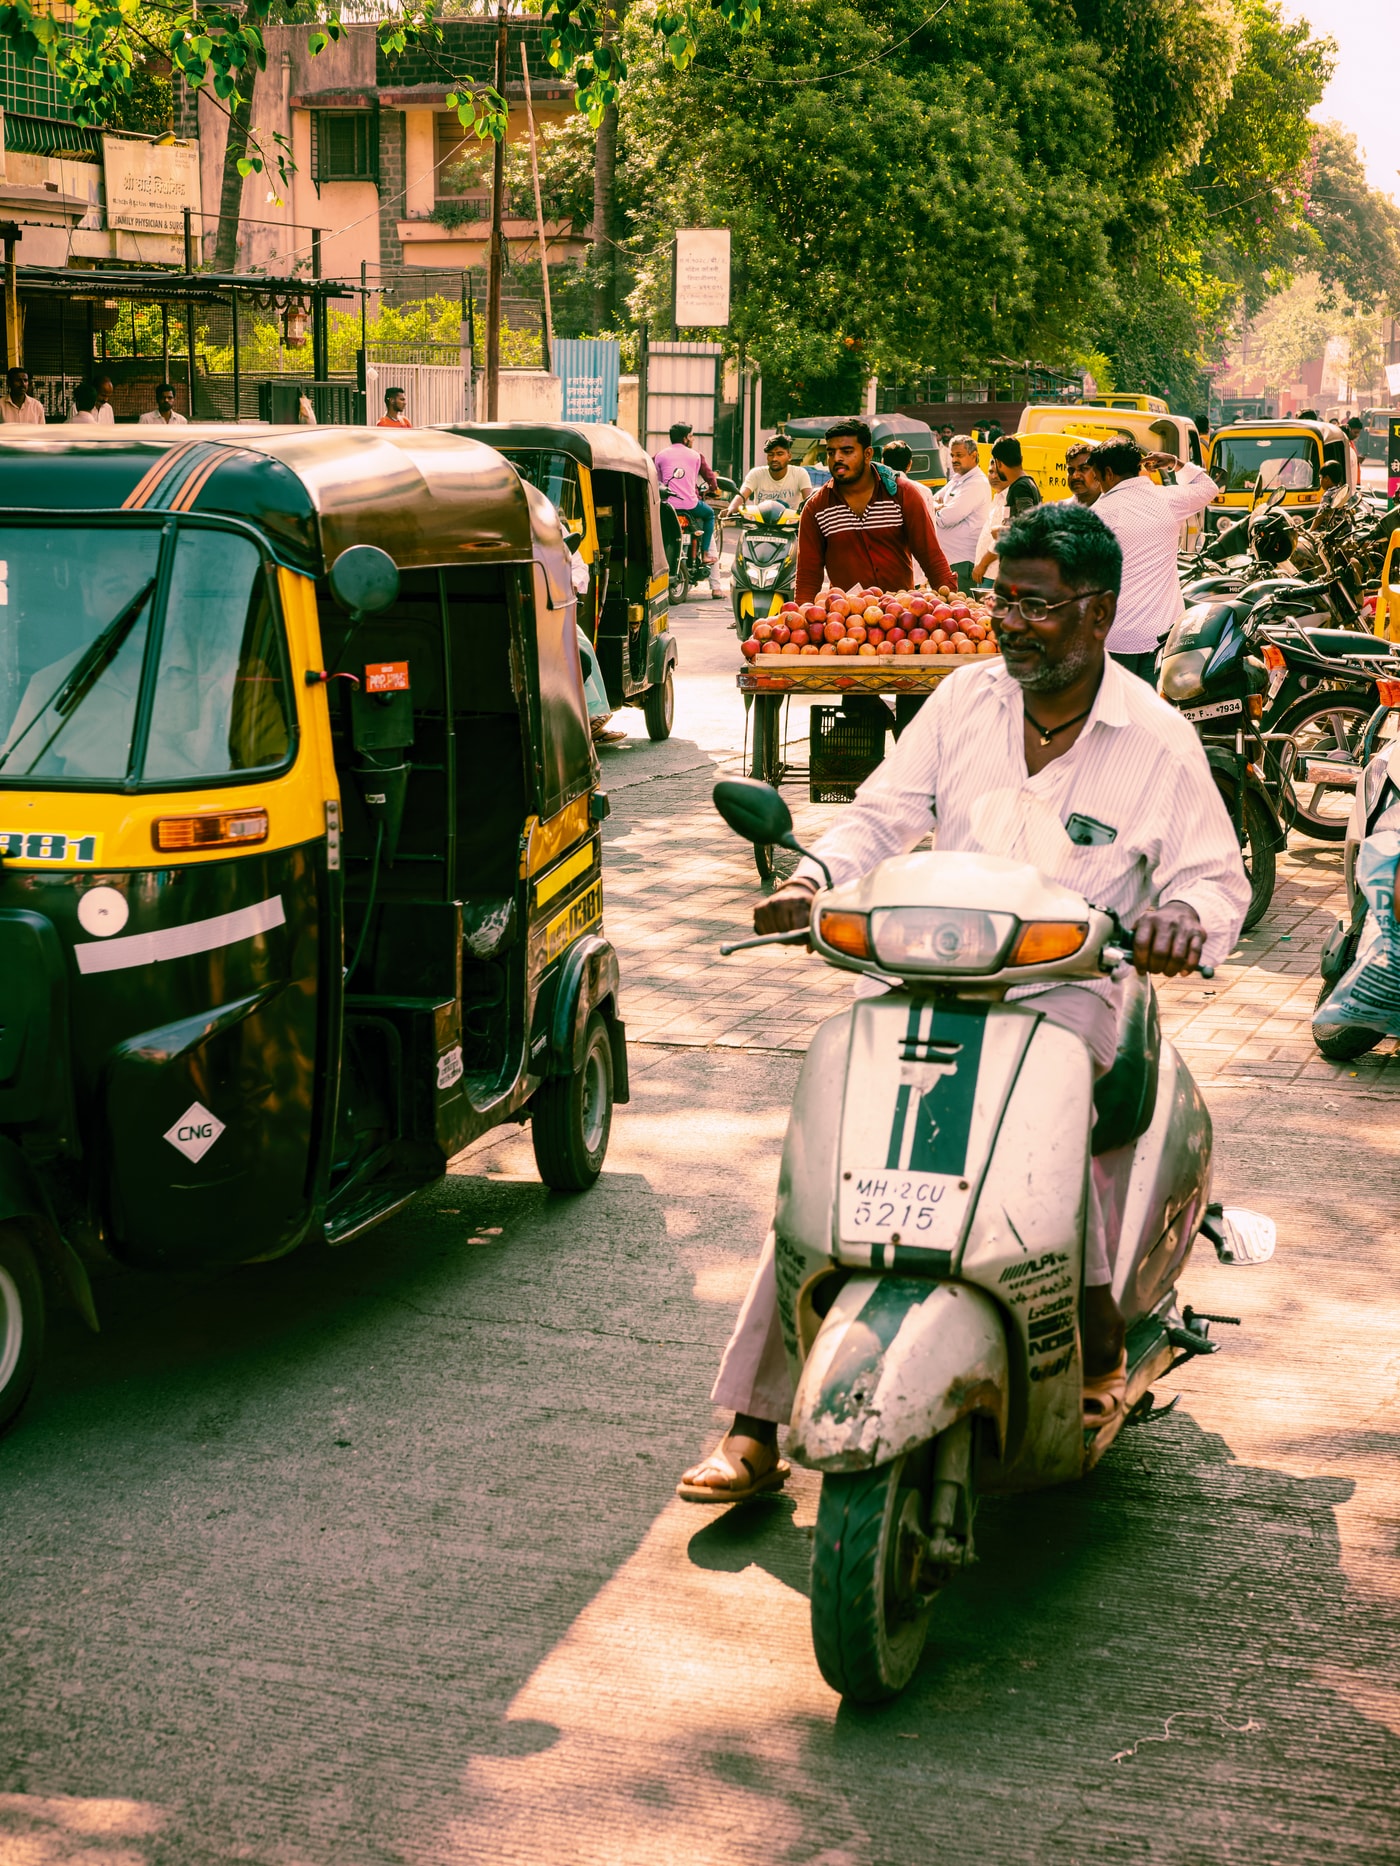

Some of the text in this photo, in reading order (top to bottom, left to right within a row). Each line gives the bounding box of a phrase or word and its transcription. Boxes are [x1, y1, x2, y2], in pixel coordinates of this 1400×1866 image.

[135, 218, 163, 229] PHYSICIAN
[164, 221, 168, 229] &
[169, 221, 195, 232] SURGN
[568, 882, 600, 939] 0381
[178, 1123, 213, 1141] CNG
[856, 1179, 888, 1197] MH
[916, 1183, 945, 1203] CU
[854, 1201, 936, 1231] 5215
